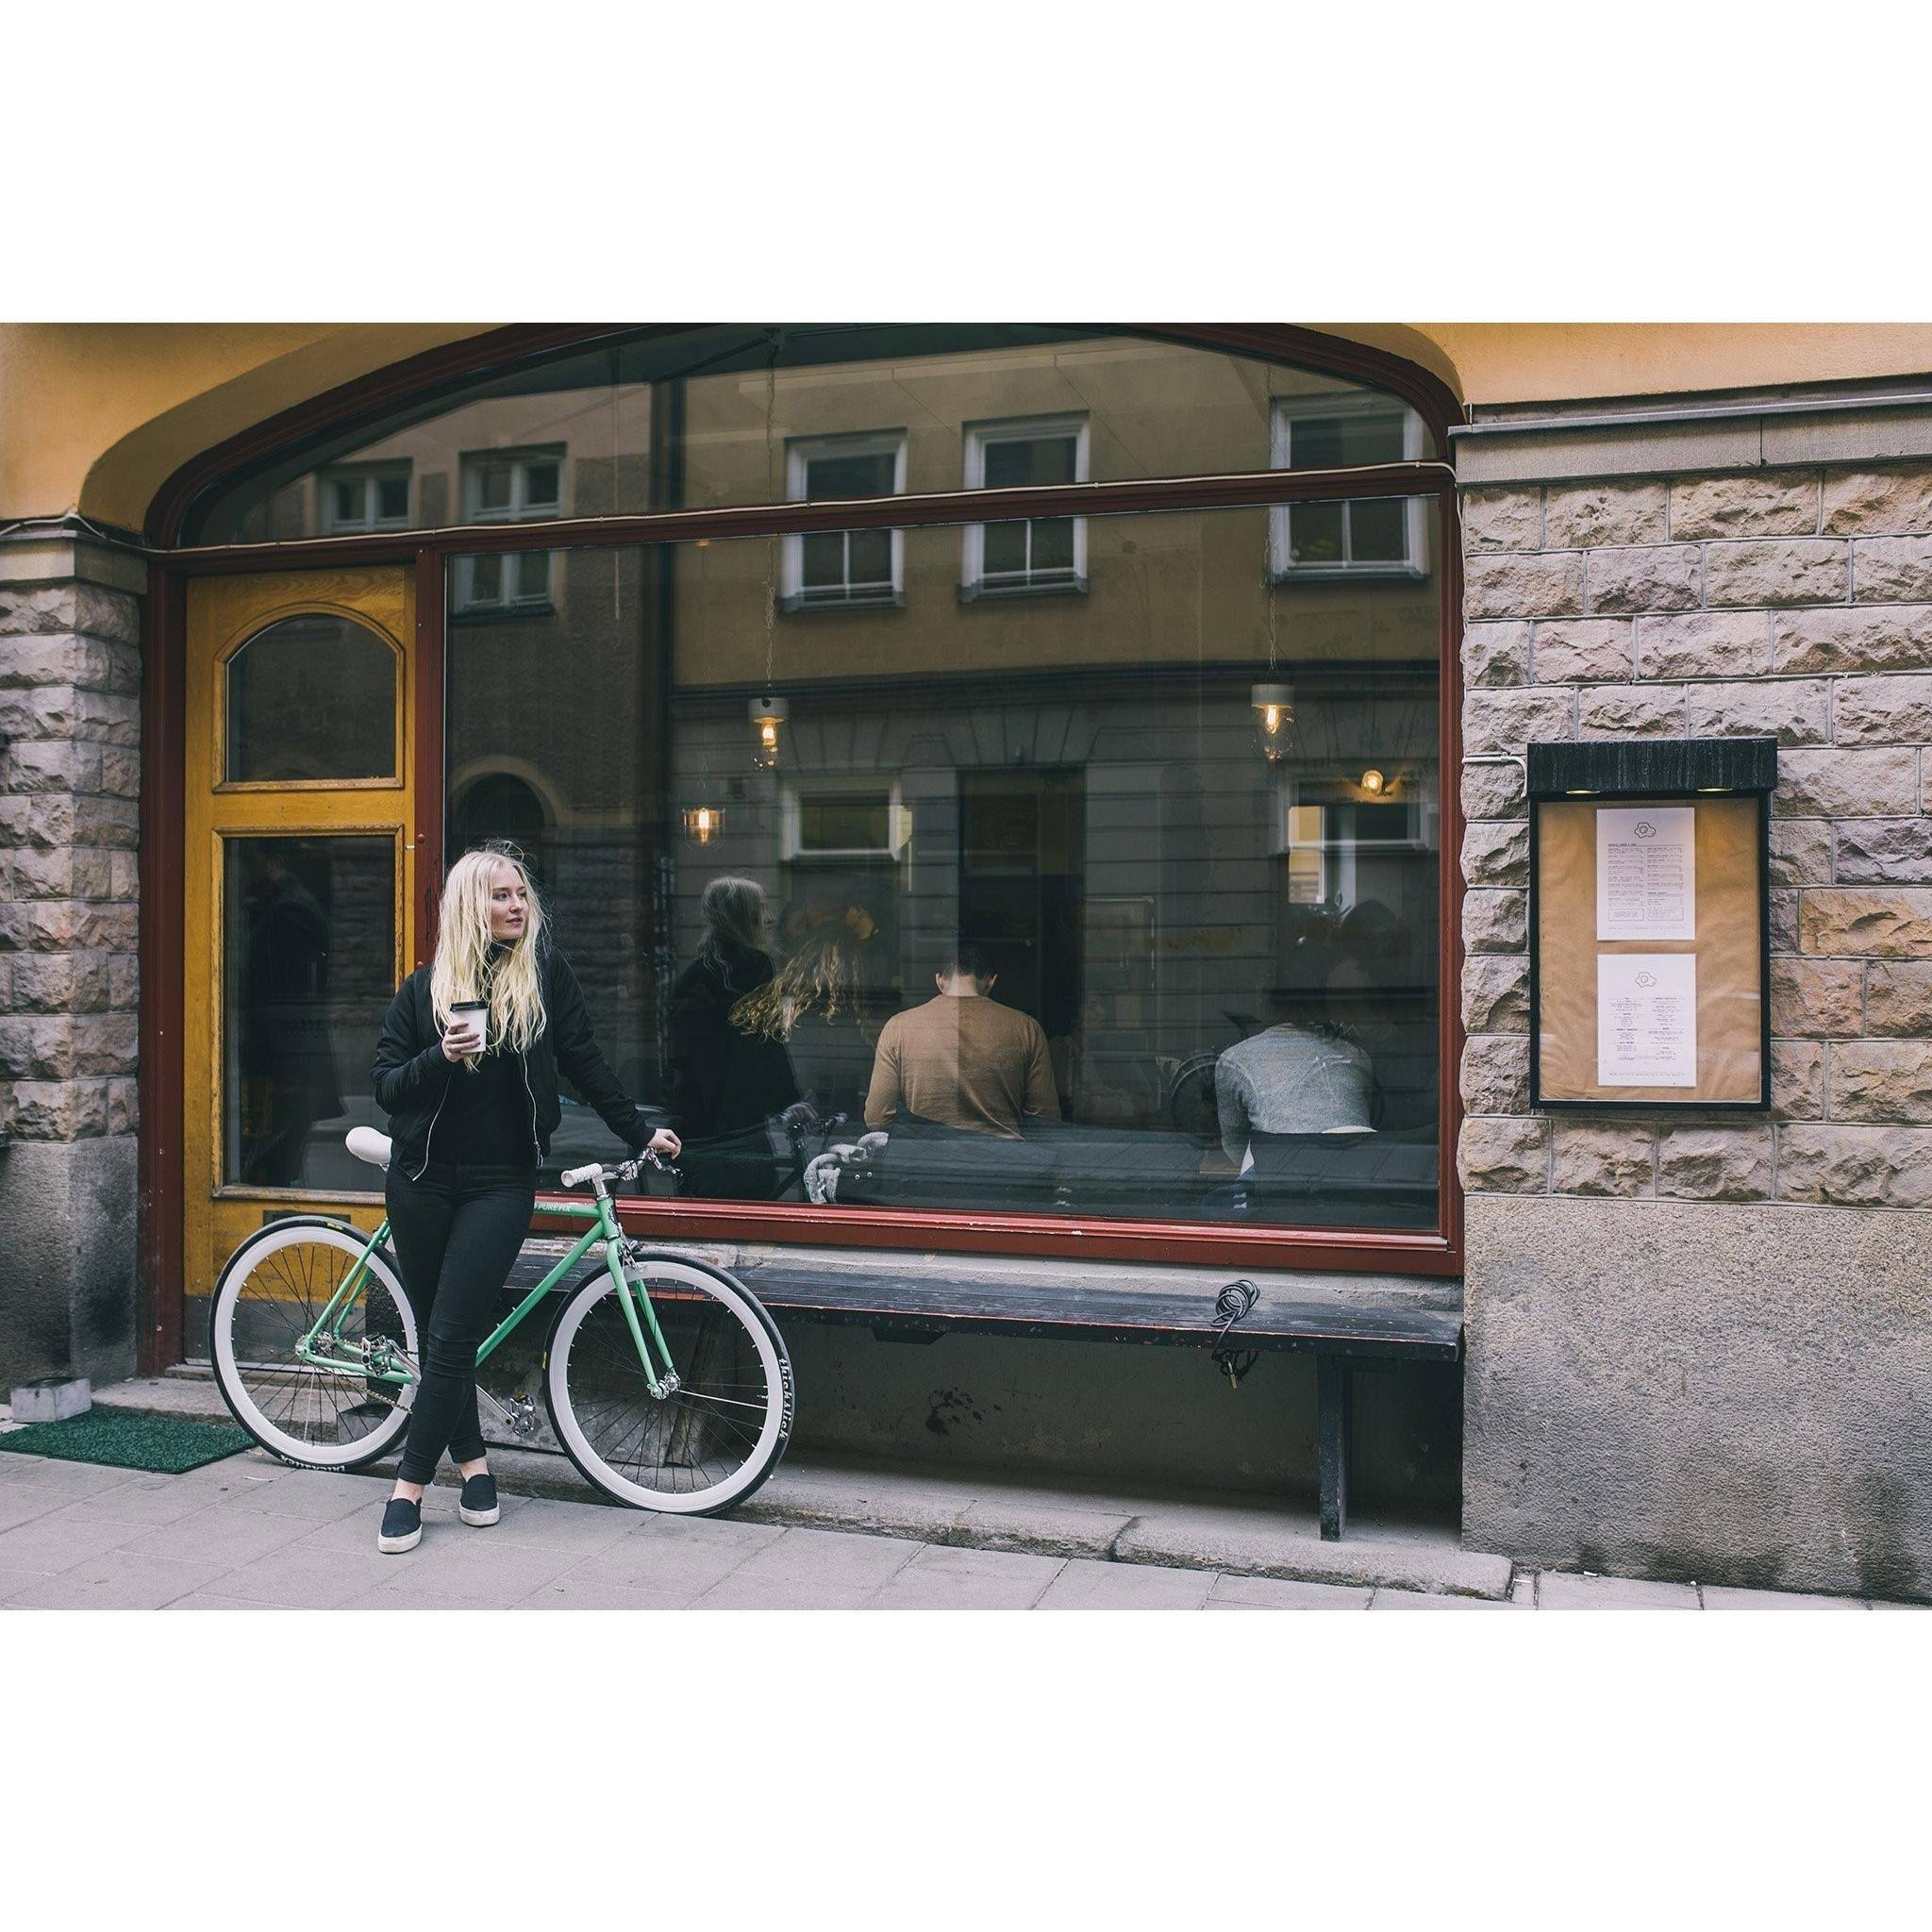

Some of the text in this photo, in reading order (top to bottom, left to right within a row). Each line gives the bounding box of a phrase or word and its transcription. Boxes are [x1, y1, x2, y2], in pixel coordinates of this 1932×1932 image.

[538, 1202, 572, 1212] PURE FIX
[778, 1357, 792, 1441] thickslick
